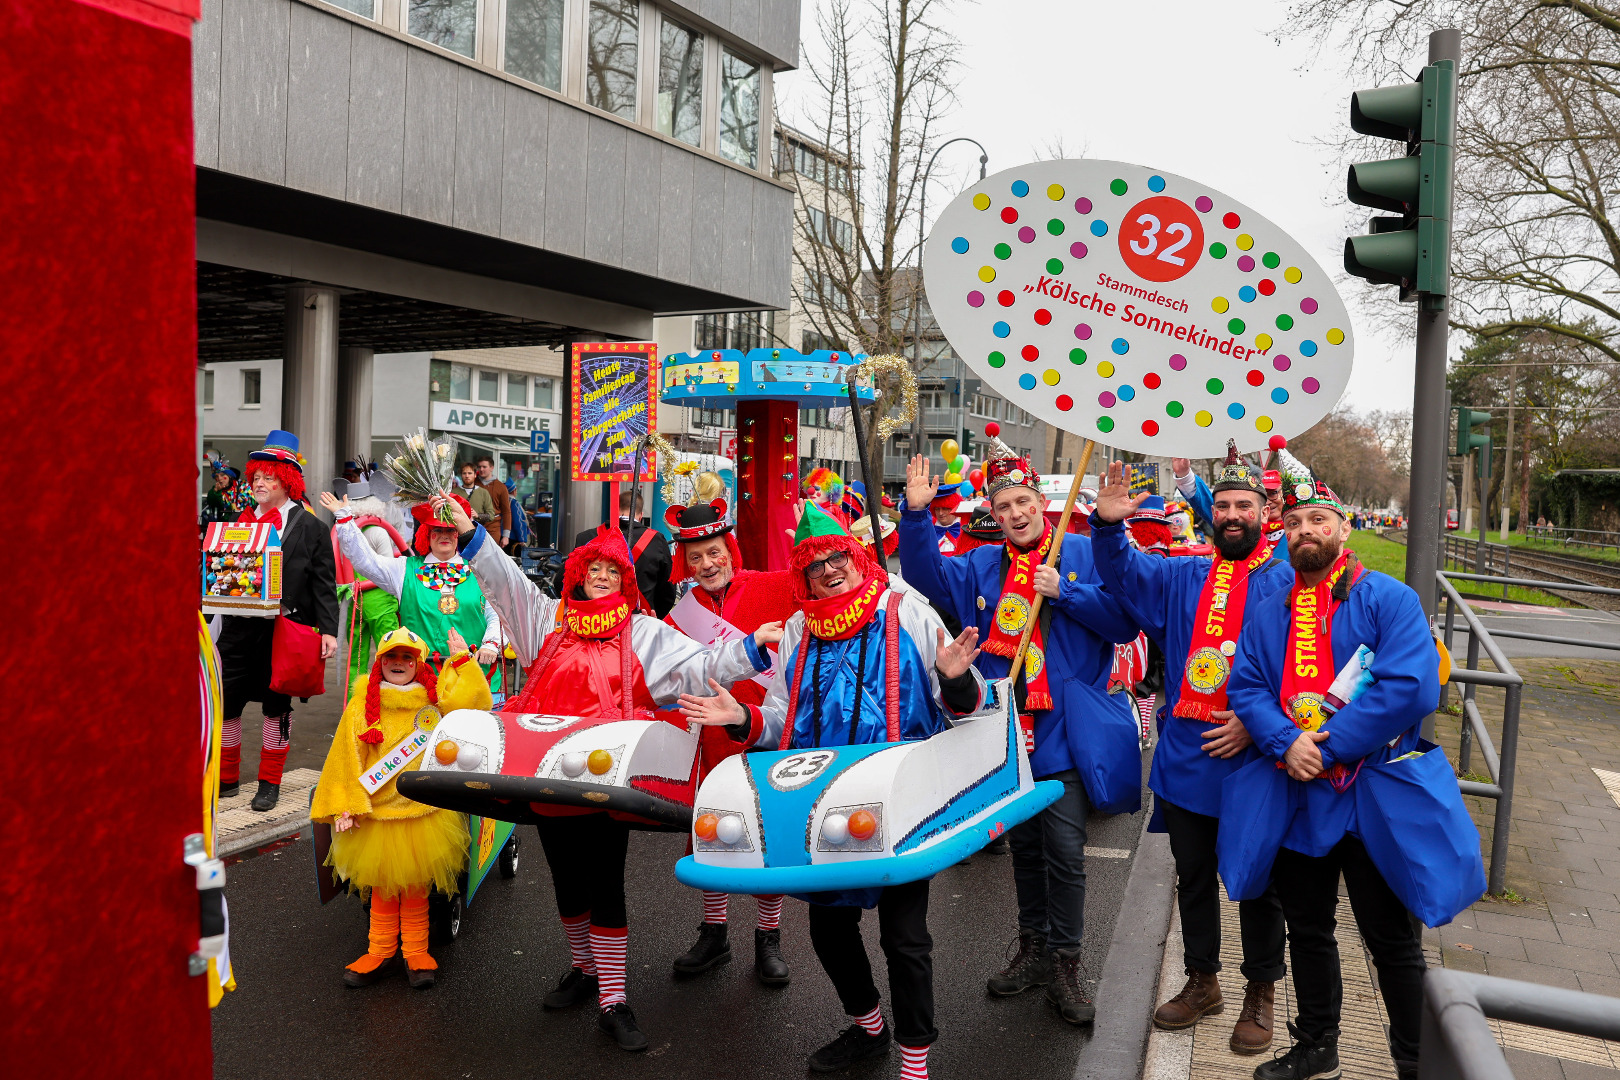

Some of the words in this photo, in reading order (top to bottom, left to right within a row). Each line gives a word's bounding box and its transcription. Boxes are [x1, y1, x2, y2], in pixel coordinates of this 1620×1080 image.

[1129, 213, 1193, 267] 32
[1096, 273, 1189, 314] Stammdesch
[593, 361, 621, 382] Heute
[583, 371, 636, 405] Familientag
[603, 397, 620, 413] alle
[446, 409, 550, 431] APOTHEKE
[534, 433, 546, 450] P
[606, 430, 626, 447] zum
[600, 452, 613, 469] 1/2
[368, 756, 402, 785] Jecke
[400, 734, 428, 758] Ente
[775, 754, 830, 779] 23
